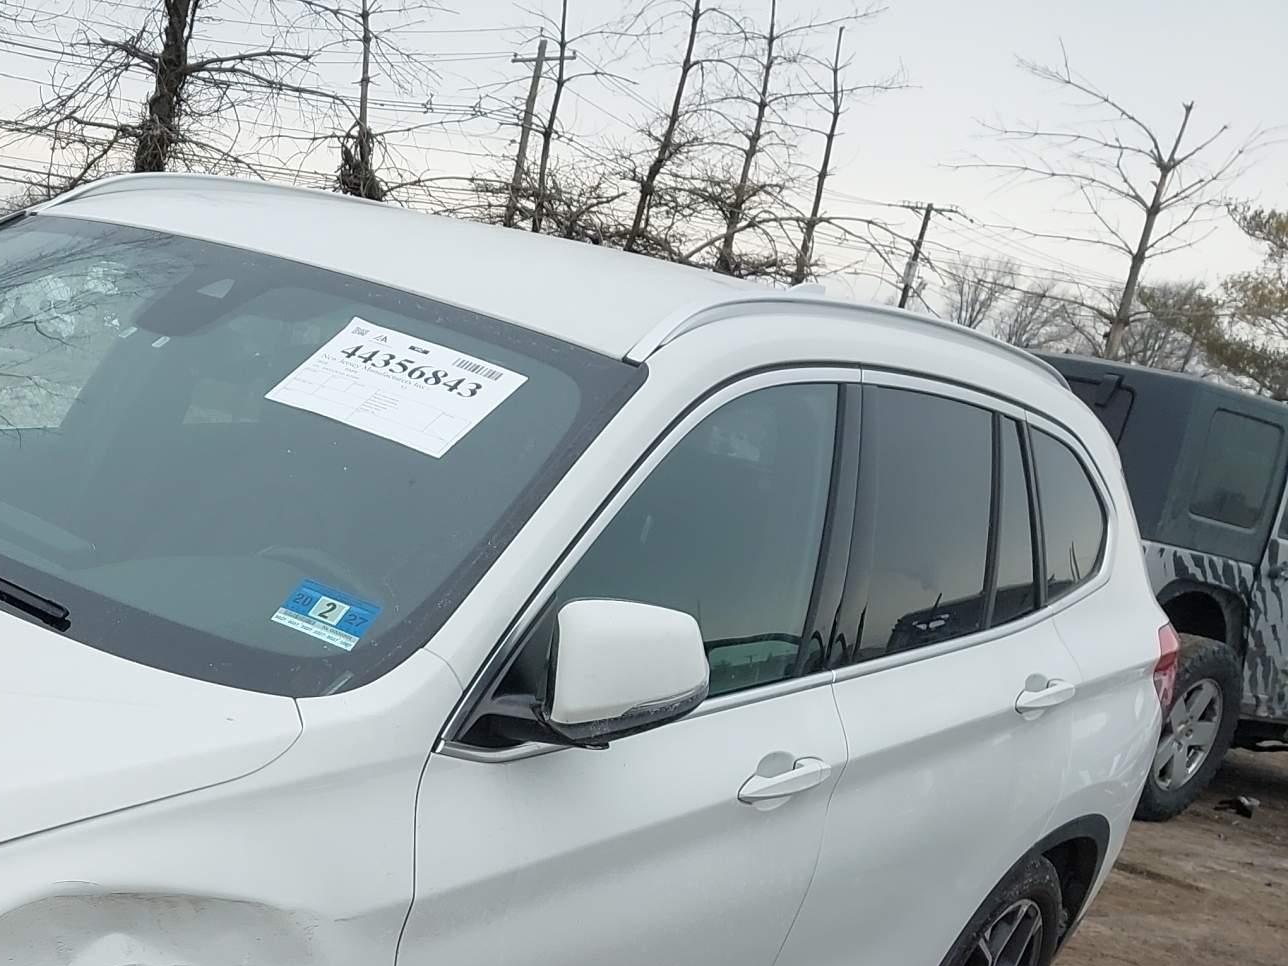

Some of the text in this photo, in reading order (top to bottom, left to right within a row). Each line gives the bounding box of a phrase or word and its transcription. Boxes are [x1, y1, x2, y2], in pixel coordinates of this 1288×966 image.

[341, 344, 483, 398] 44356843
[294, 592, 312, 607] 20
[318, 602, 337, 619] 2
[345, 613, 368, 628] 27
